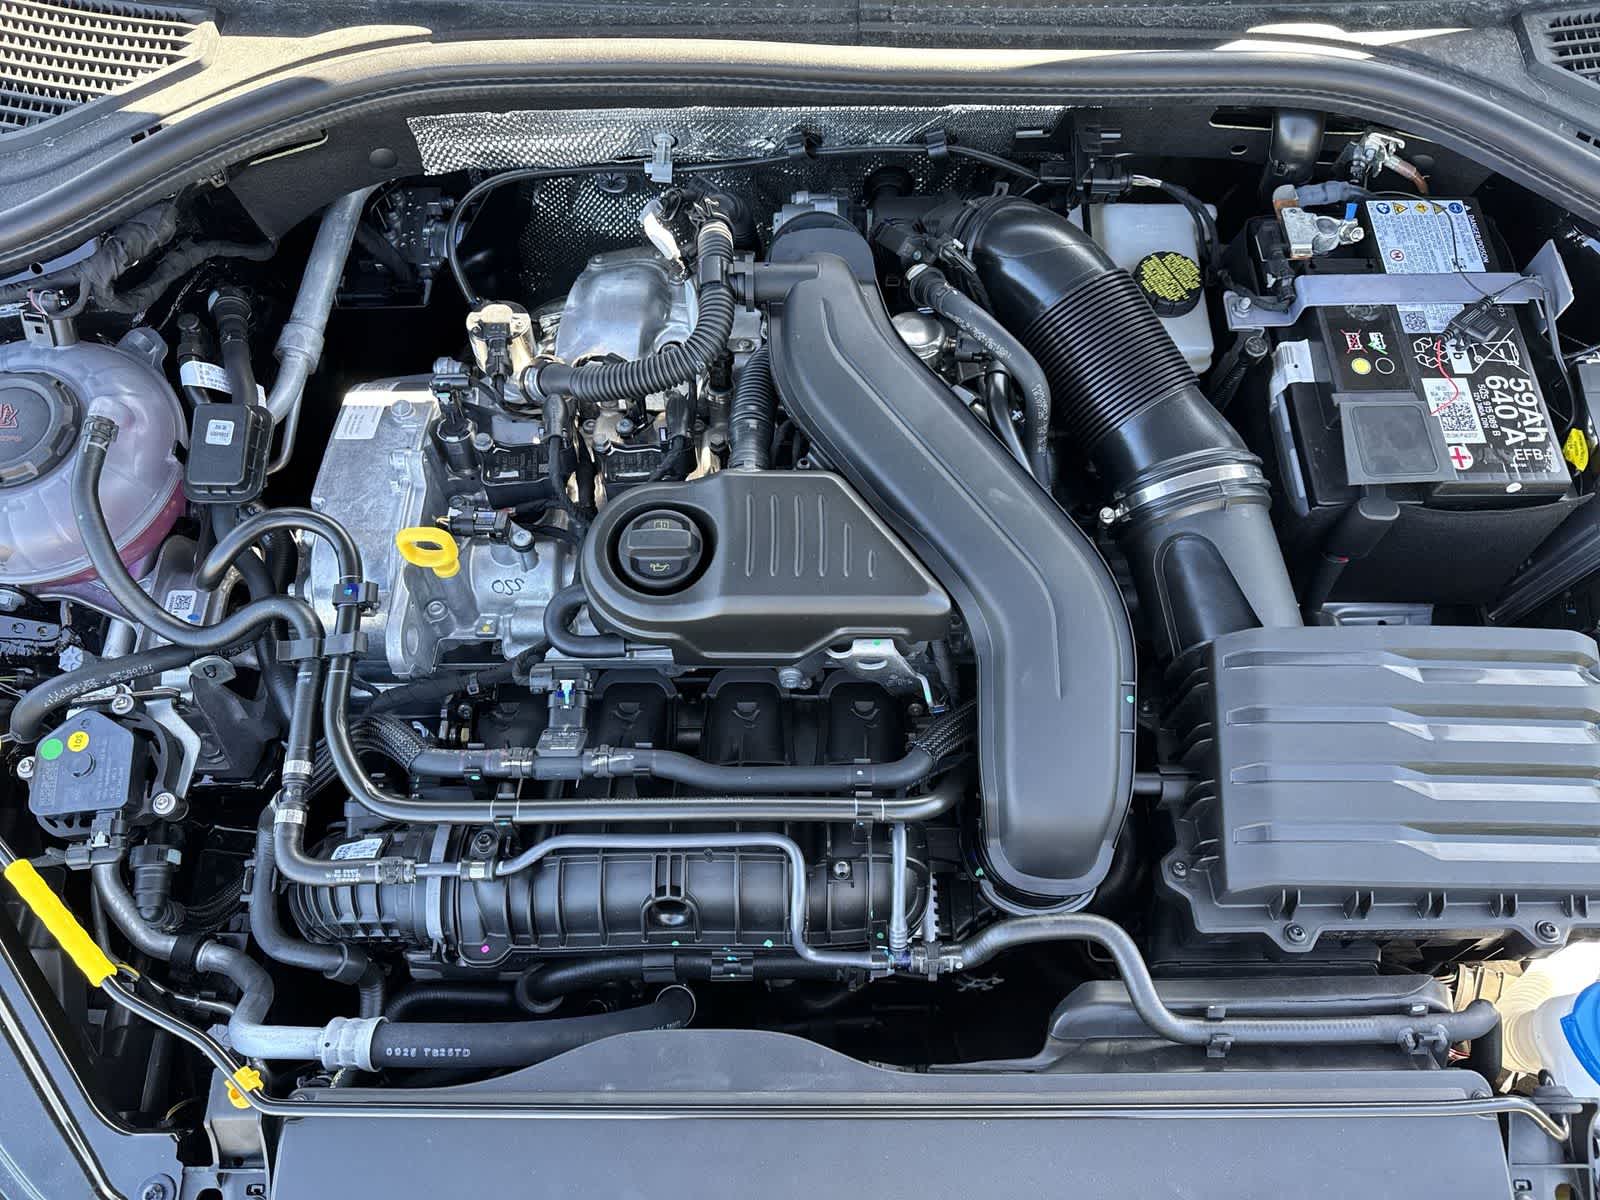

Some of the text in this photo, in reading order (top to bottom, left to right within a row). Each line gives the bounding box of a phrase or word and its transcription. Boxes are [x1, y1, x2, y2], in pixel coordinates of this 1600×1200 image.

[1483, 401, 1494, 414] 915
[1485, 375, 1519, 420] 640
[1509, 377, 1548, 443] 59Ah
[1500, 426, 1527, 446] A
